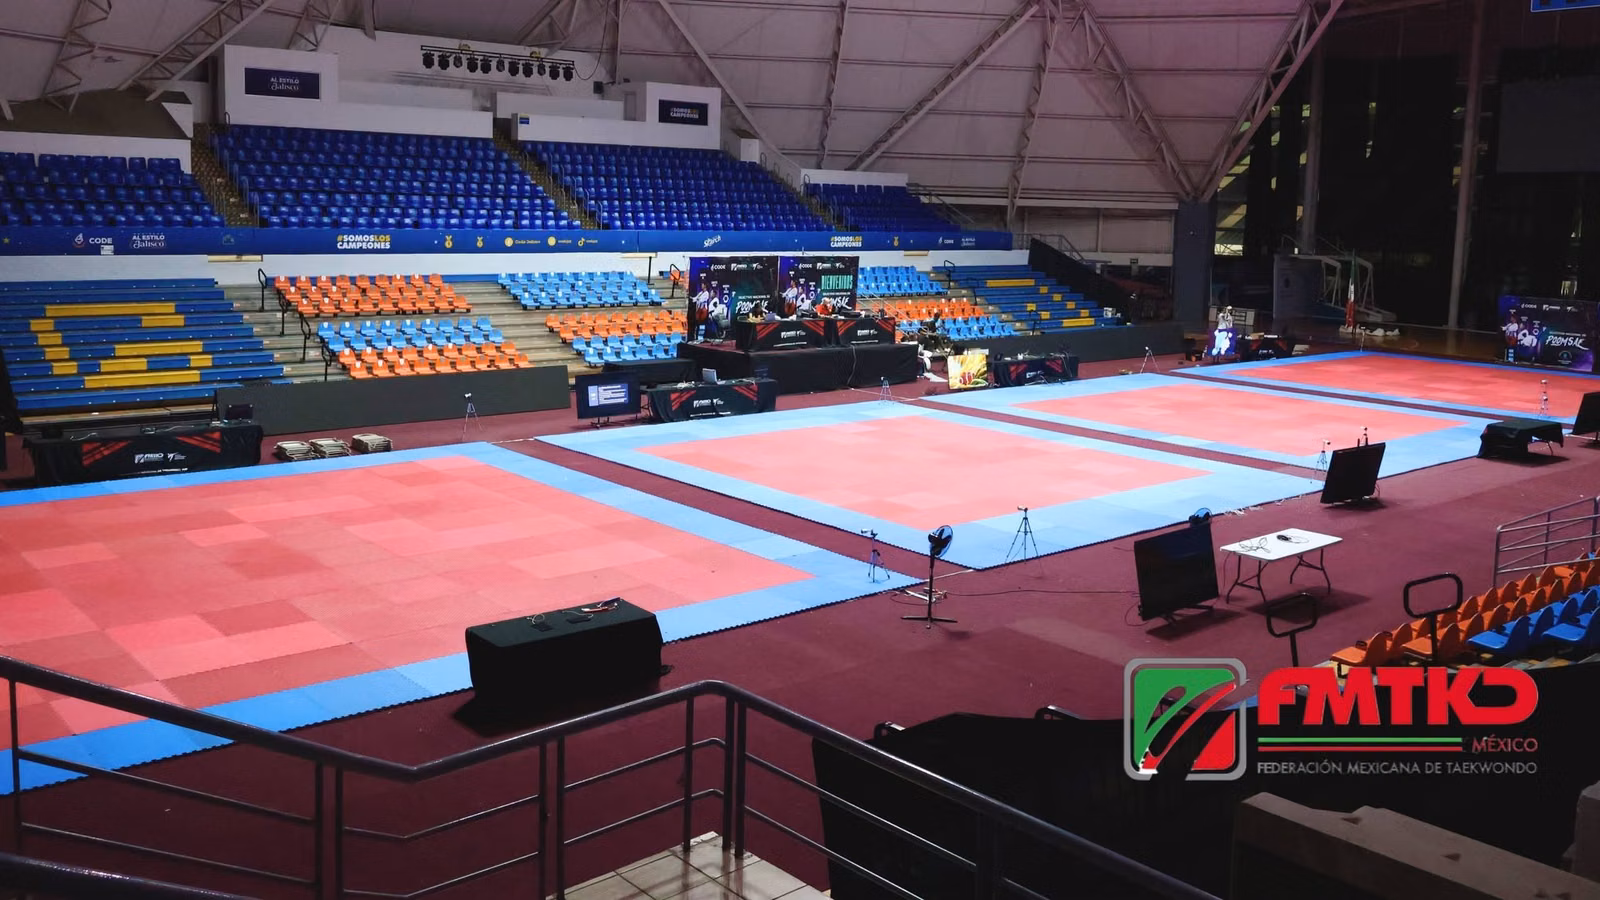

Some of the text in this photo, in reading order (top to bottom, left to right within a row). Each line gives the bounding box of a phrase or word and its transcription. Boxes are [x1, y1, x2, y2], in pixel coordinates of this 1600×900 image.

[133, 240, 165, 248] Jalisco
[337, 241, 391, 249] CAMPEONES
[1545, 335, 1590, 350] POOMSAE
